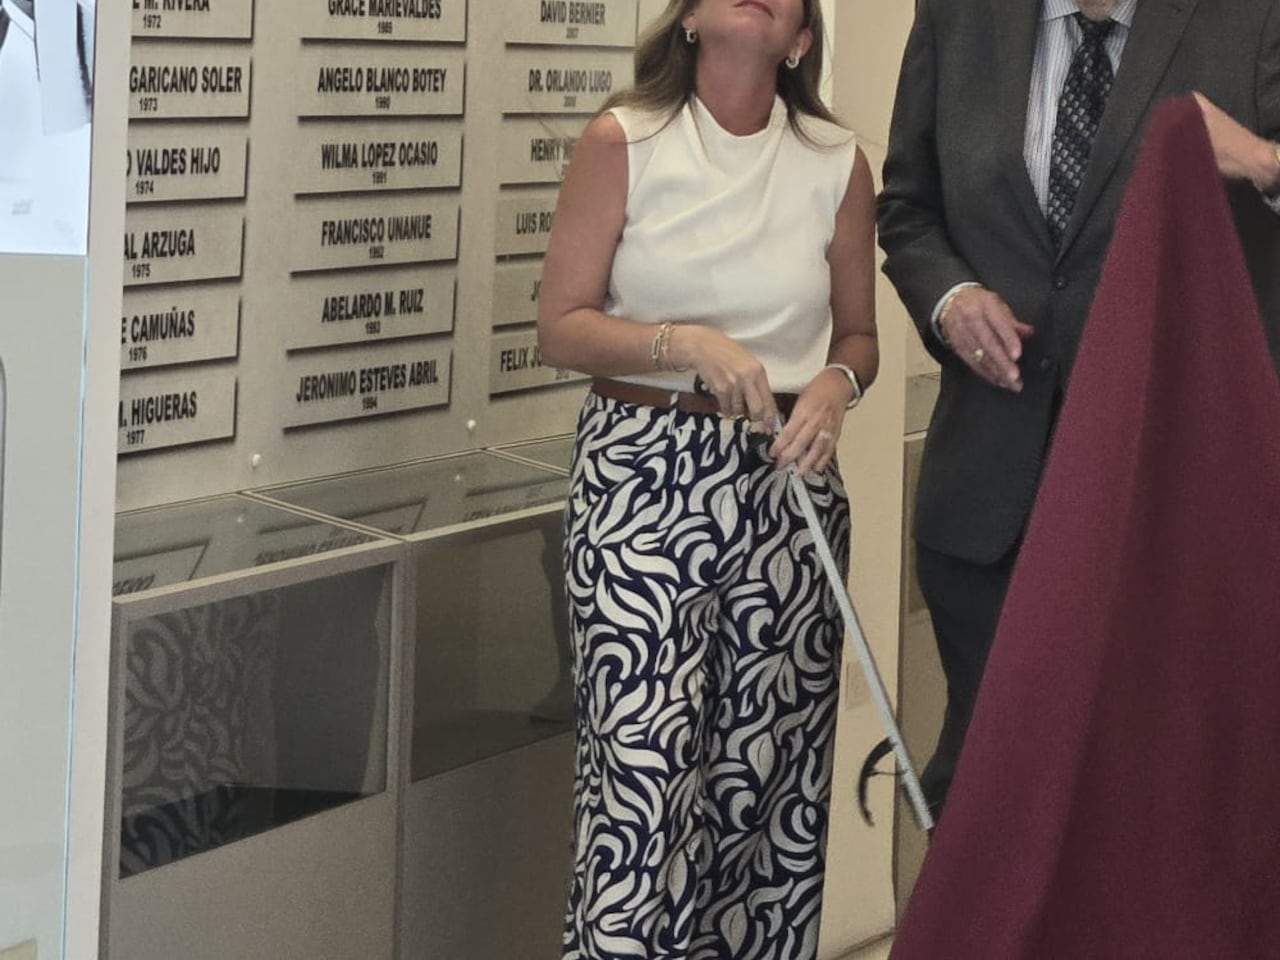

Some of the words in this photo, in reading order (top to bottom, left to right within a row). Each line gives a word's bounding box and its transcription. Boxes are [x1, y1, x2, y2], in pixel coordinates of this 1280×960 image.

[143, 14, 161, 29] 1972
[541, 0, 566, 24] DAVID
[569, 1, 605, 26] BERNIER
[129, 66, 197, 93] GARICANO
[201, 66, 242, 93] SOLER
[318, 67, 363, 93] ANGELO
[366, 68, 410, 92] BLANCO
[412, 68, 446, 92] BOTEY
[529, 69, 543, 92] DR.
[546, 70, 587, 92] ORLANDO
[590, 71, 612, 92] LUGO
[139, 97, 158, 111] 1973
[137, 148, 186, 176] VALDES
[190, 147, 220, 174] HIJO
[322, 143, 358, 169] WILMA
[362, 143, 396, 168] LOPEZ
[399, 141, 438, 166] OCASIO
[136, 180, 154, 195] 1974
[321, 218, 384, 246] FRANCISCO
[388, 215, 432, 241] UNANUE
[516, 212, 537, 235] LUIS
[141, 228, 195, 258] ARZUGA
[132, 264, 150, 278] 1975
[322, 293, 382, 323] ABELARDO
[400, 289, 424, 314] RUIZ
[131, 306, 194, 343] CAMUÑAS
[129, 347, 147, 361] 1976
[500, 348, 529, 373] FELIX
[296, 370, 356, 403] JERONIMO
[360, 364, 407, 394] ESTEVES
[409, 360, 438, 387] ABRIL
[132, 392, 197, 426] HIGUERAS
[126, 430, 145, 445] 1977
